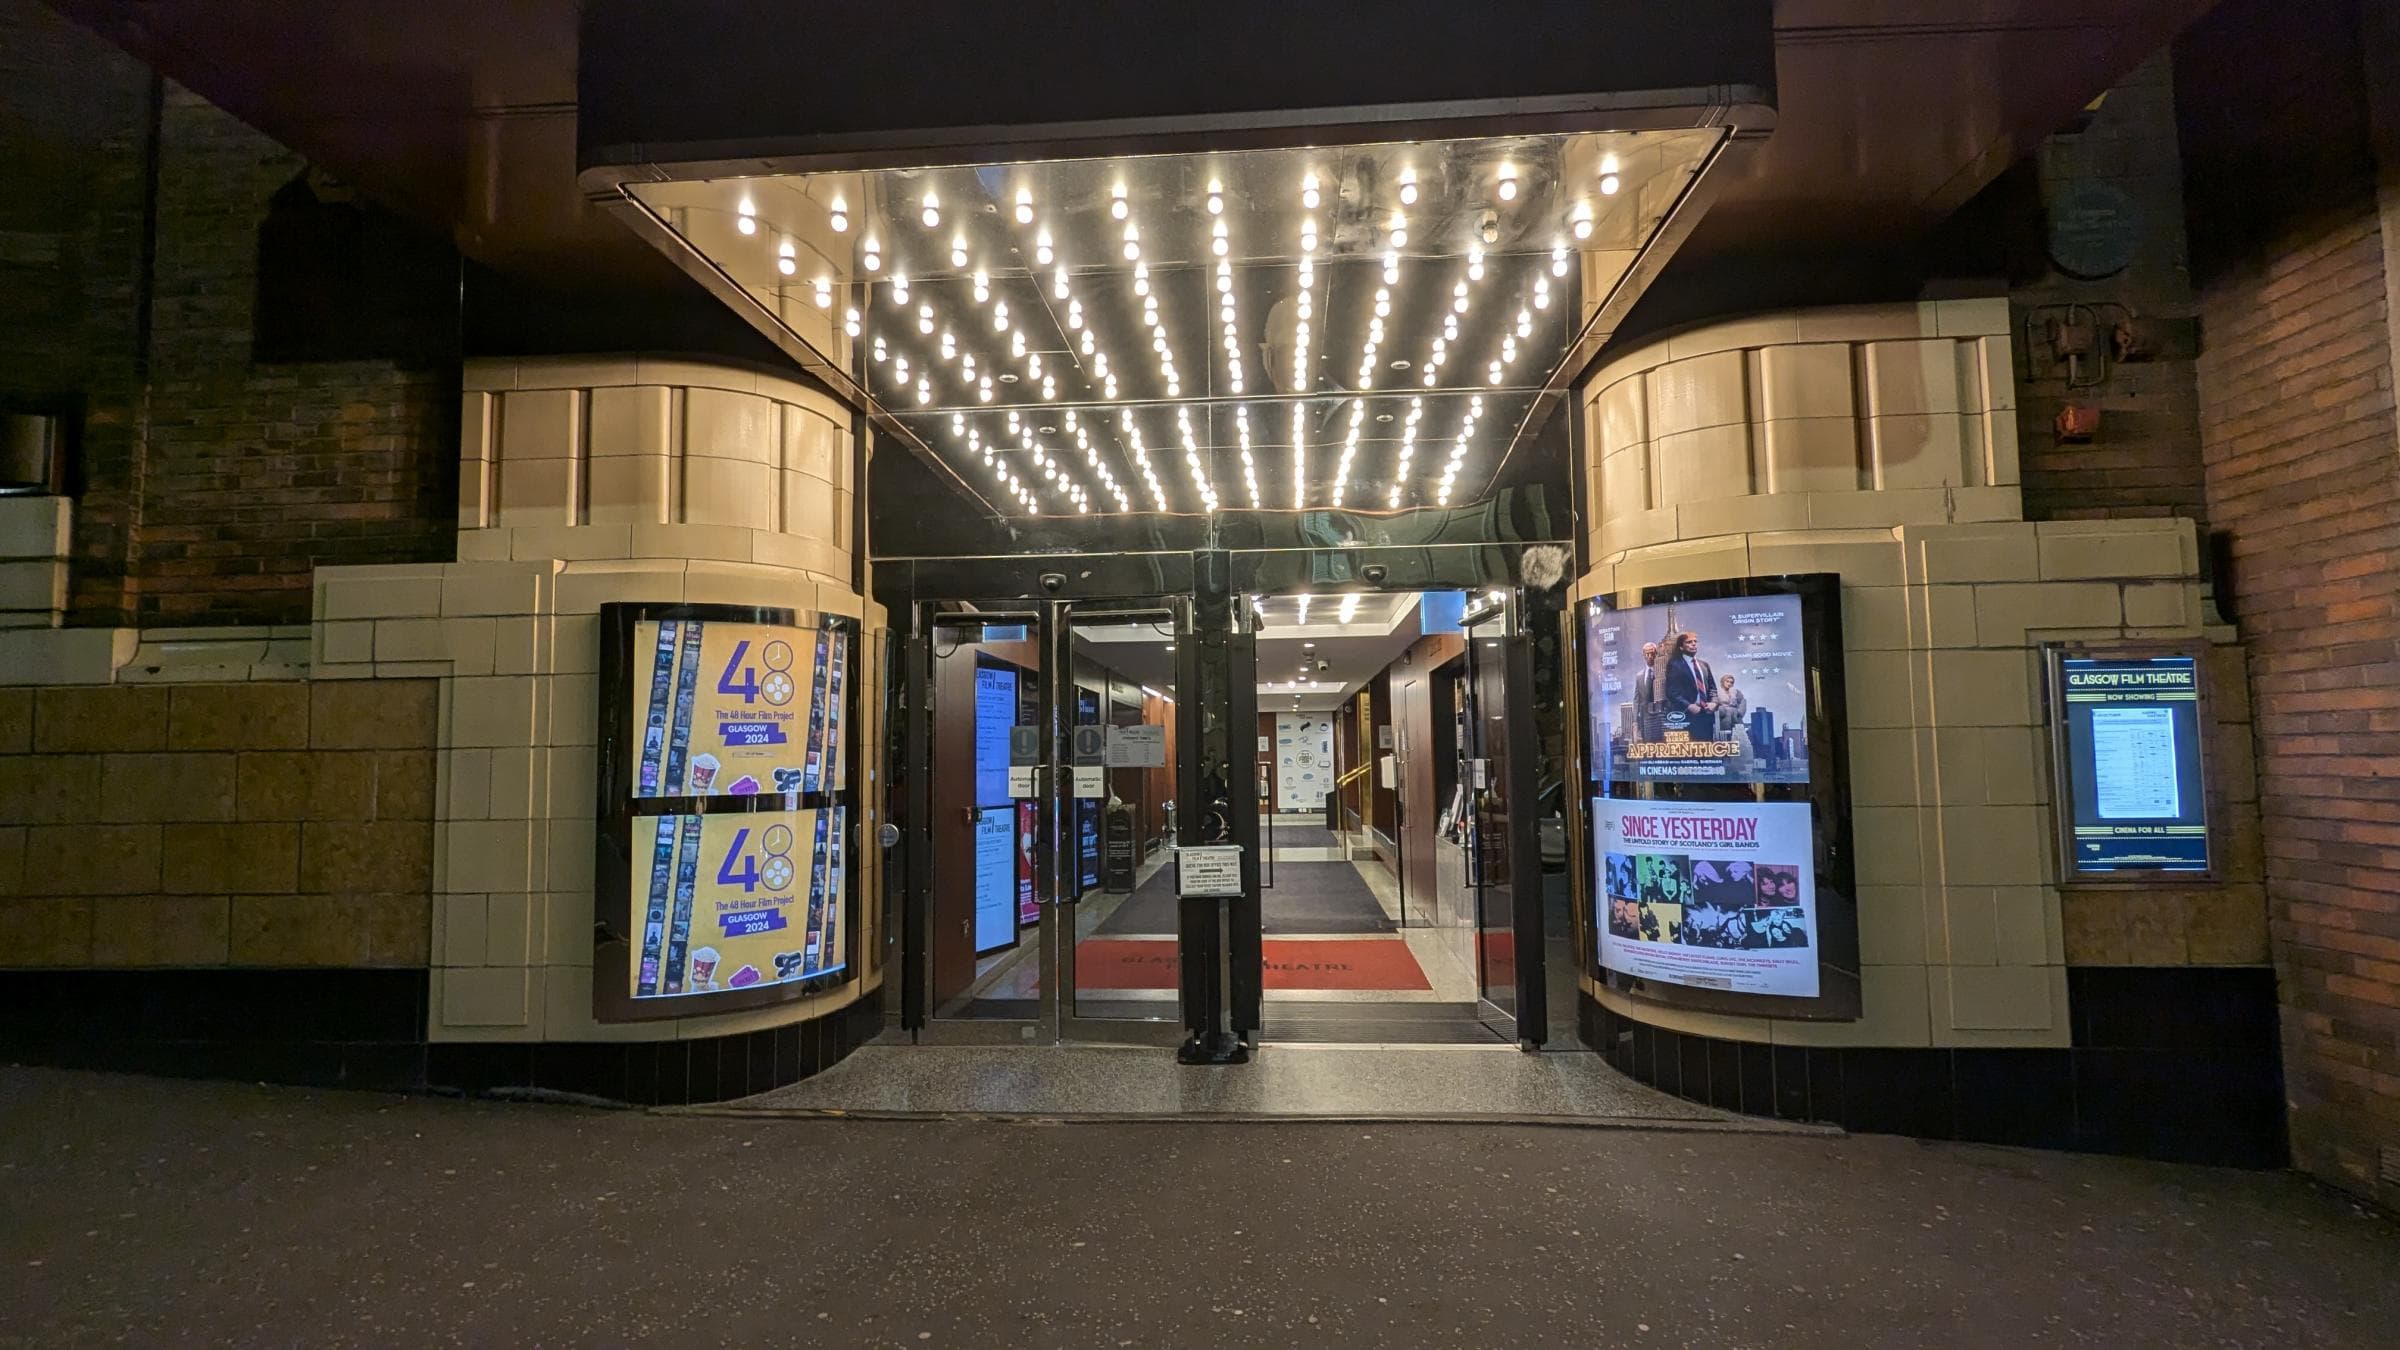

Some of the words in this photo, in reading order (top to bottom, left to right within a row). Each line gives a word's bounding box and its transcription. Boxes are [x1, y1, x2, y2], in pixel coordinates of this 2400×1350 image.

[2069, 674, 2119, 686] GLASGOW
[2121, 674, 2144, 684] FILM
[2146, 672, 2191, 684] THEATRE
[715, 710, 728, 720] The
[730, 710, 739, 720] 48
[740, 710, 756, 720] Hour
[758, 711, 773, 720] Film
[773, 711, 795, 722] Project
[728, 725, 767, 733] GLASGOW
[745, 734, 769, 743] 2024
[1664, 731, 1690, 742] THE
[1626, 741, 1741, 759] APPRENTICE
[1639, 766, 1645, 776] IN
[1647, 766, 1677, 776] CINEMAS
[1621, 815, 1658, 838] SINCE
[1661, 816, 1759, 841] YESTERDAY
[2138, 826, 2152, 834] FOR
[1652, 838, 1669, 846] STORY
[1669, 839, 1677, 847] OF
[1679, 840, 1718, 848] SCOTLAND'S
[715, 901, 728, 911] The
[730, 900, 739, 909] 48
[740, 899, 756, 909] Hour
[758, 897, 773, 907] Film
[773, 895, 795, 906] Project
[728, 912, 767, 923] GLASGOW
[745, 921, 769, 933] 2024
[1265, 963, 1353, 971] HEATRE
